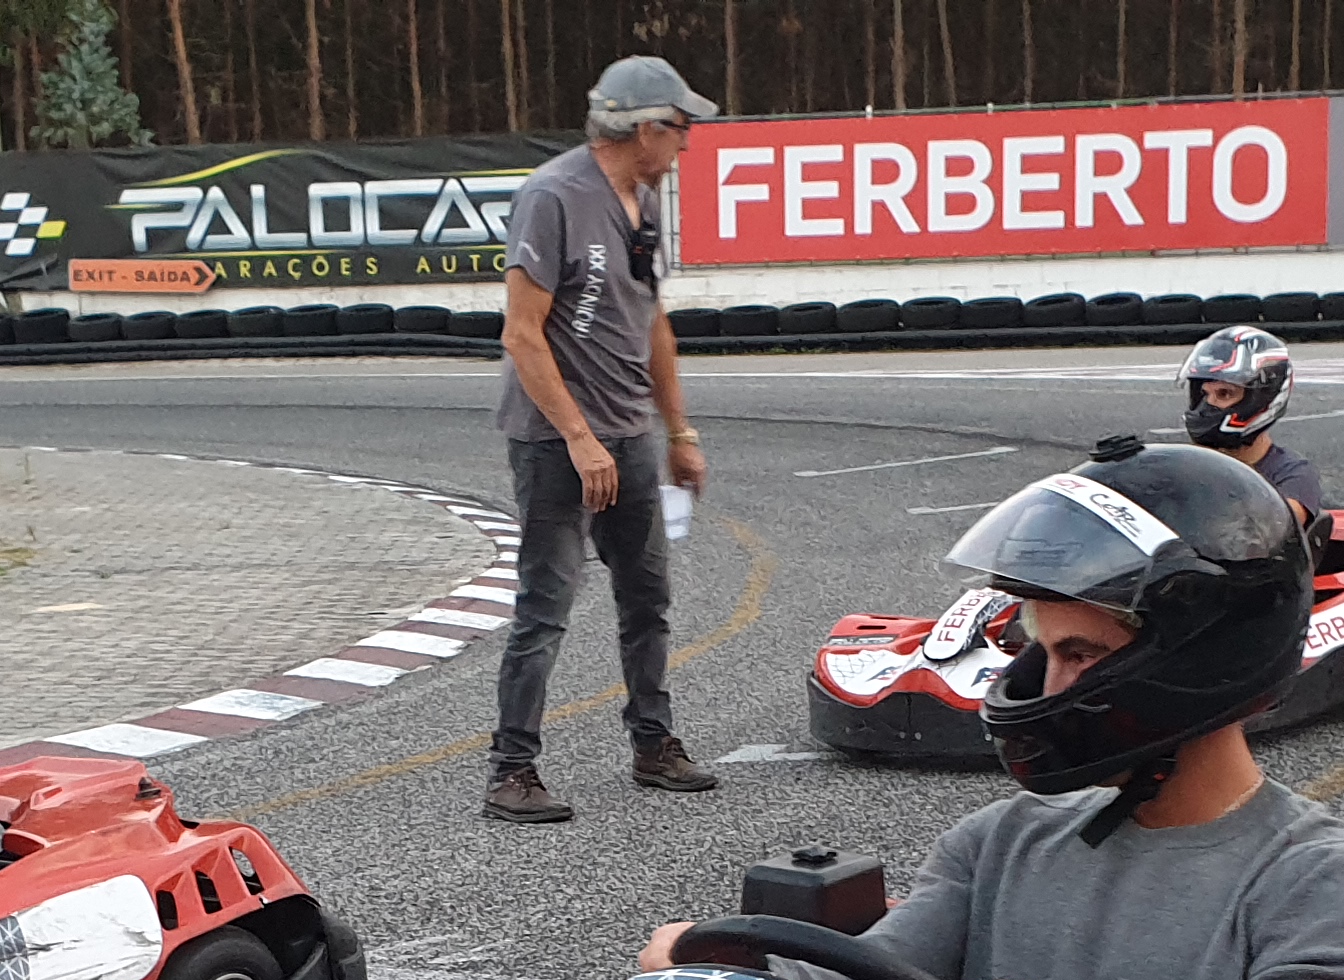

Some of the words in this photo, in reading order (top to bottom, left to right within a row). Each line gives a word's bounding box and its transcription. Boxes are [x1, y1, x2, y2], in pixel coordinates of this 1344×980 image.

[716, 124, 1288, 240] FERBERTO
[212, 253, 379, 281] ARAÇÕES
[587, 243, 605, 272] XXI
[72, 268, 117, 283] EXIT
[134, 267, 192, 284] SAÍDA
